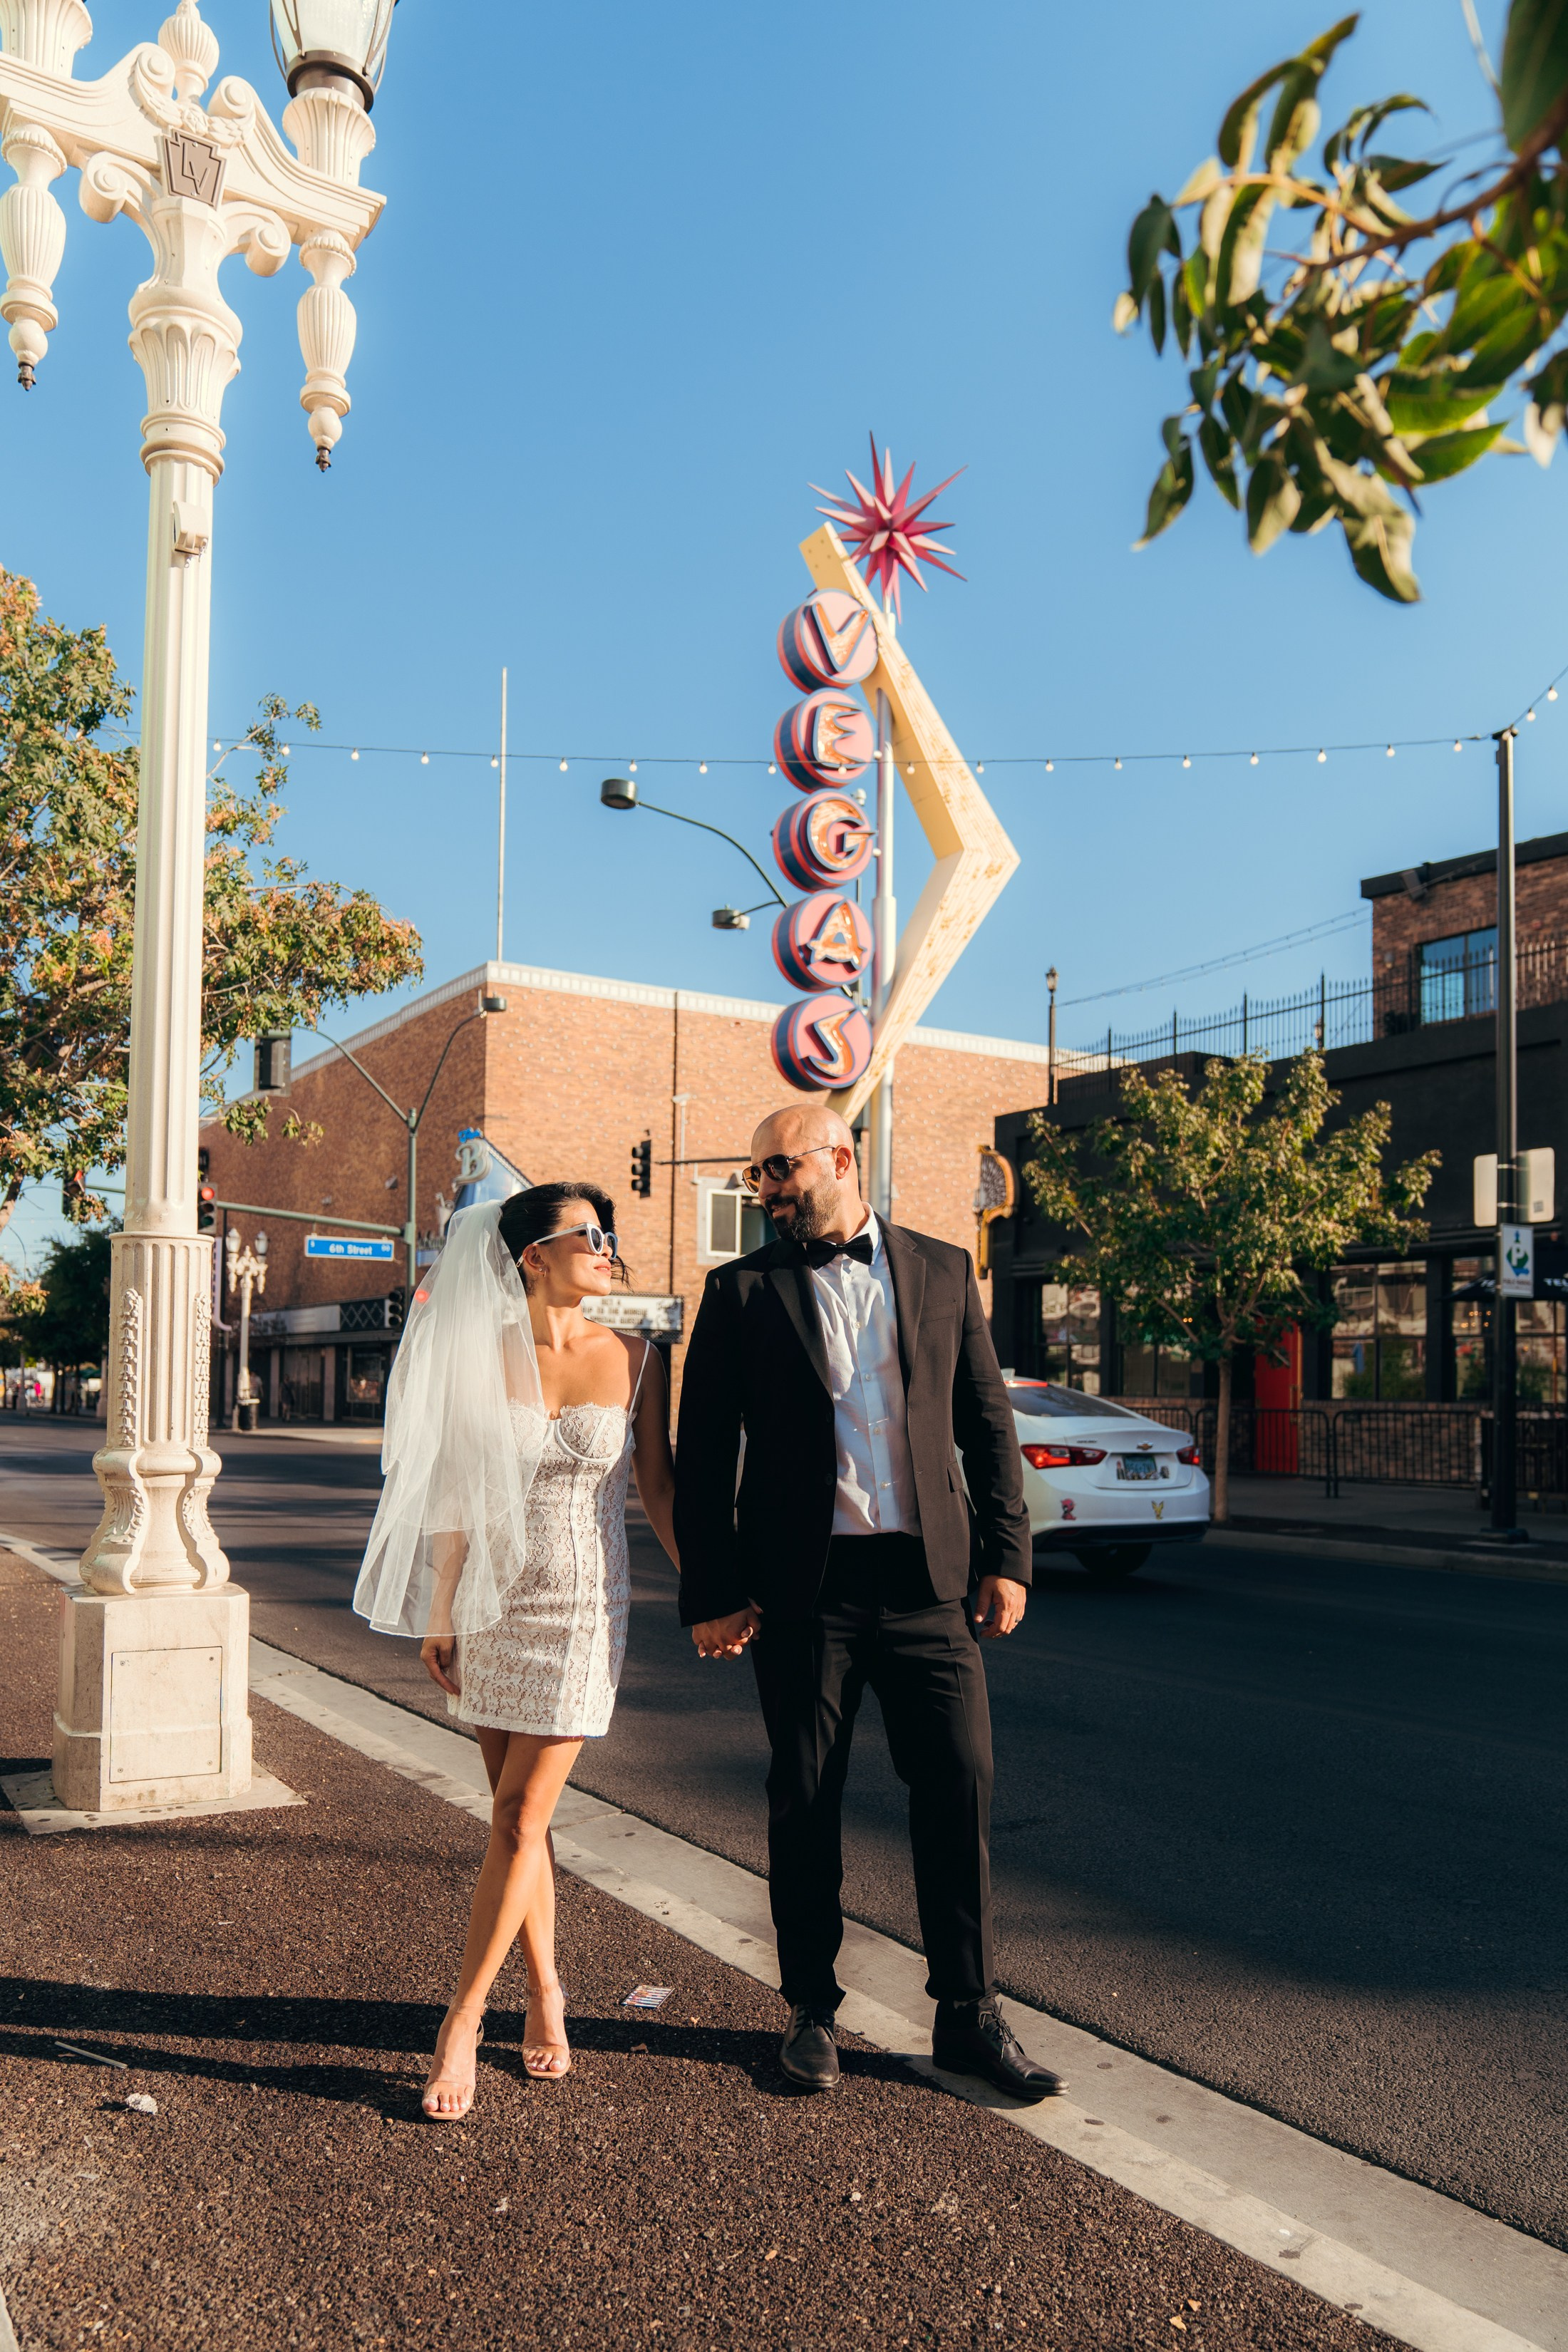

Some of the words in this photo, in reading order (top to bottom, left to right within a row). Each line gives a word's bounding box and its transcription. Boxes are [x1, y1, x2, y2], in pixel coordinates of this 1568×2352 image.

[181, 141, 210, 195] LV
[797, 599, 878, 1080] VEGAS
[329, 1243, 344, 1254] 6th
[347, 1244, 372, 1255] Street
[1512, 1243, 1525, 1267] P
